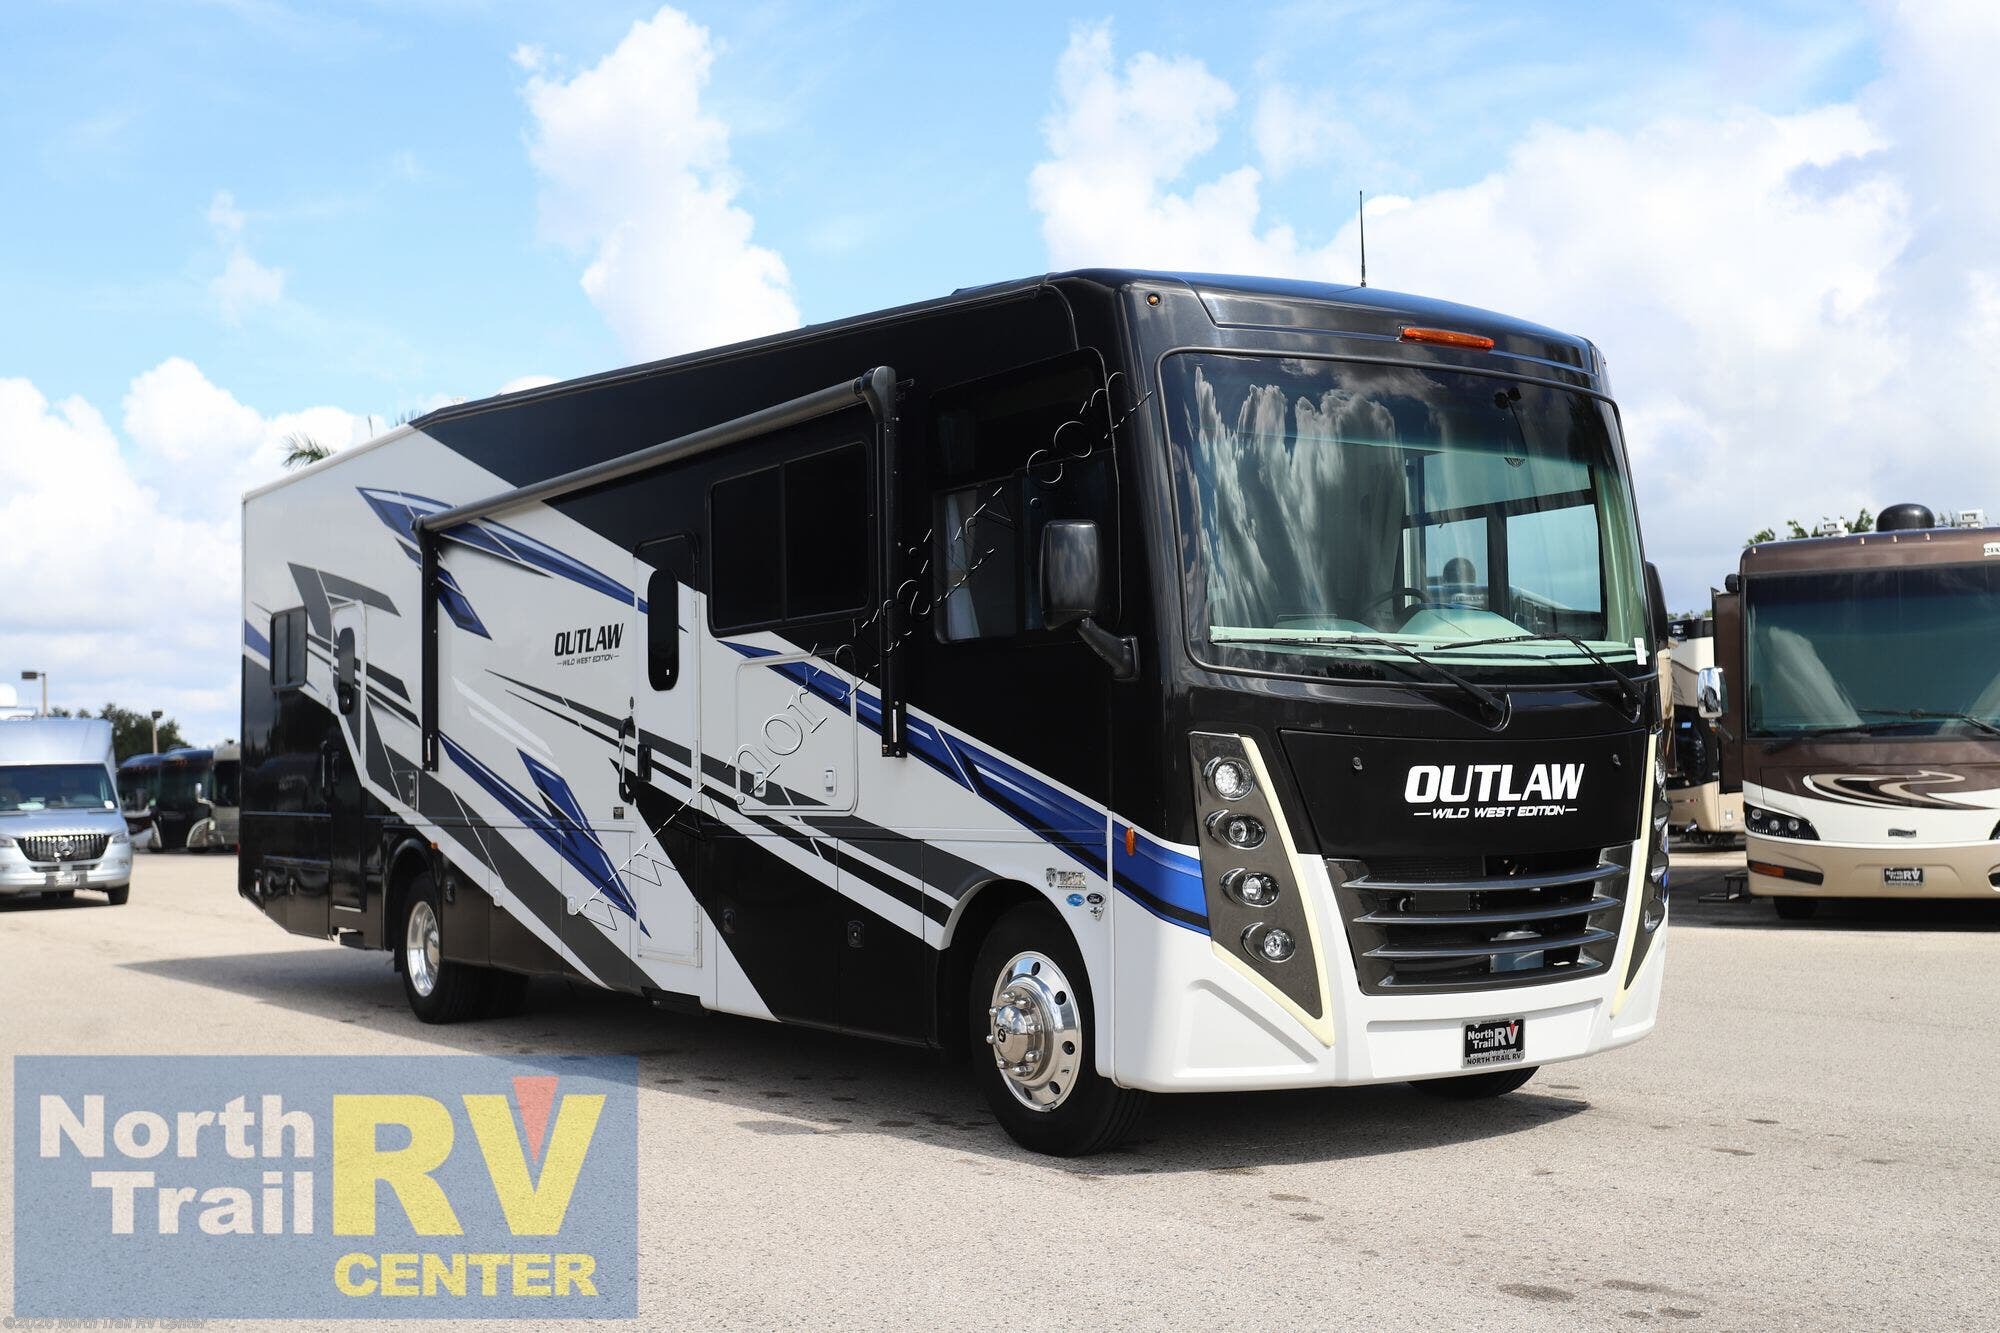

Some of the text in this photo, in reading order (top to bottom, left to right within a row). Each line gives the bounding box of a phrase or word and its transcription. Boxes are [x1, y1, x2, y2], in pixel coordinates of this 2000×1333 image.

[554, 622, 624, 656] OUTLAW
[562, 653, 613, 666] WILD WEST EDITION
[1404, 763, 1585, 803] OUTLAW
[1432, 804, 1565, 819] WILD WEST EDITION
[1467, 1025, 1519, 1047] North RV
[1472, 1038, 1494, 1049] Trail
[1466, 1057, 1491, 1065] NORTH
[1492, 1054, 1511, 1062] TRAIL
[1512, 1052, 1522, 1060] RV
